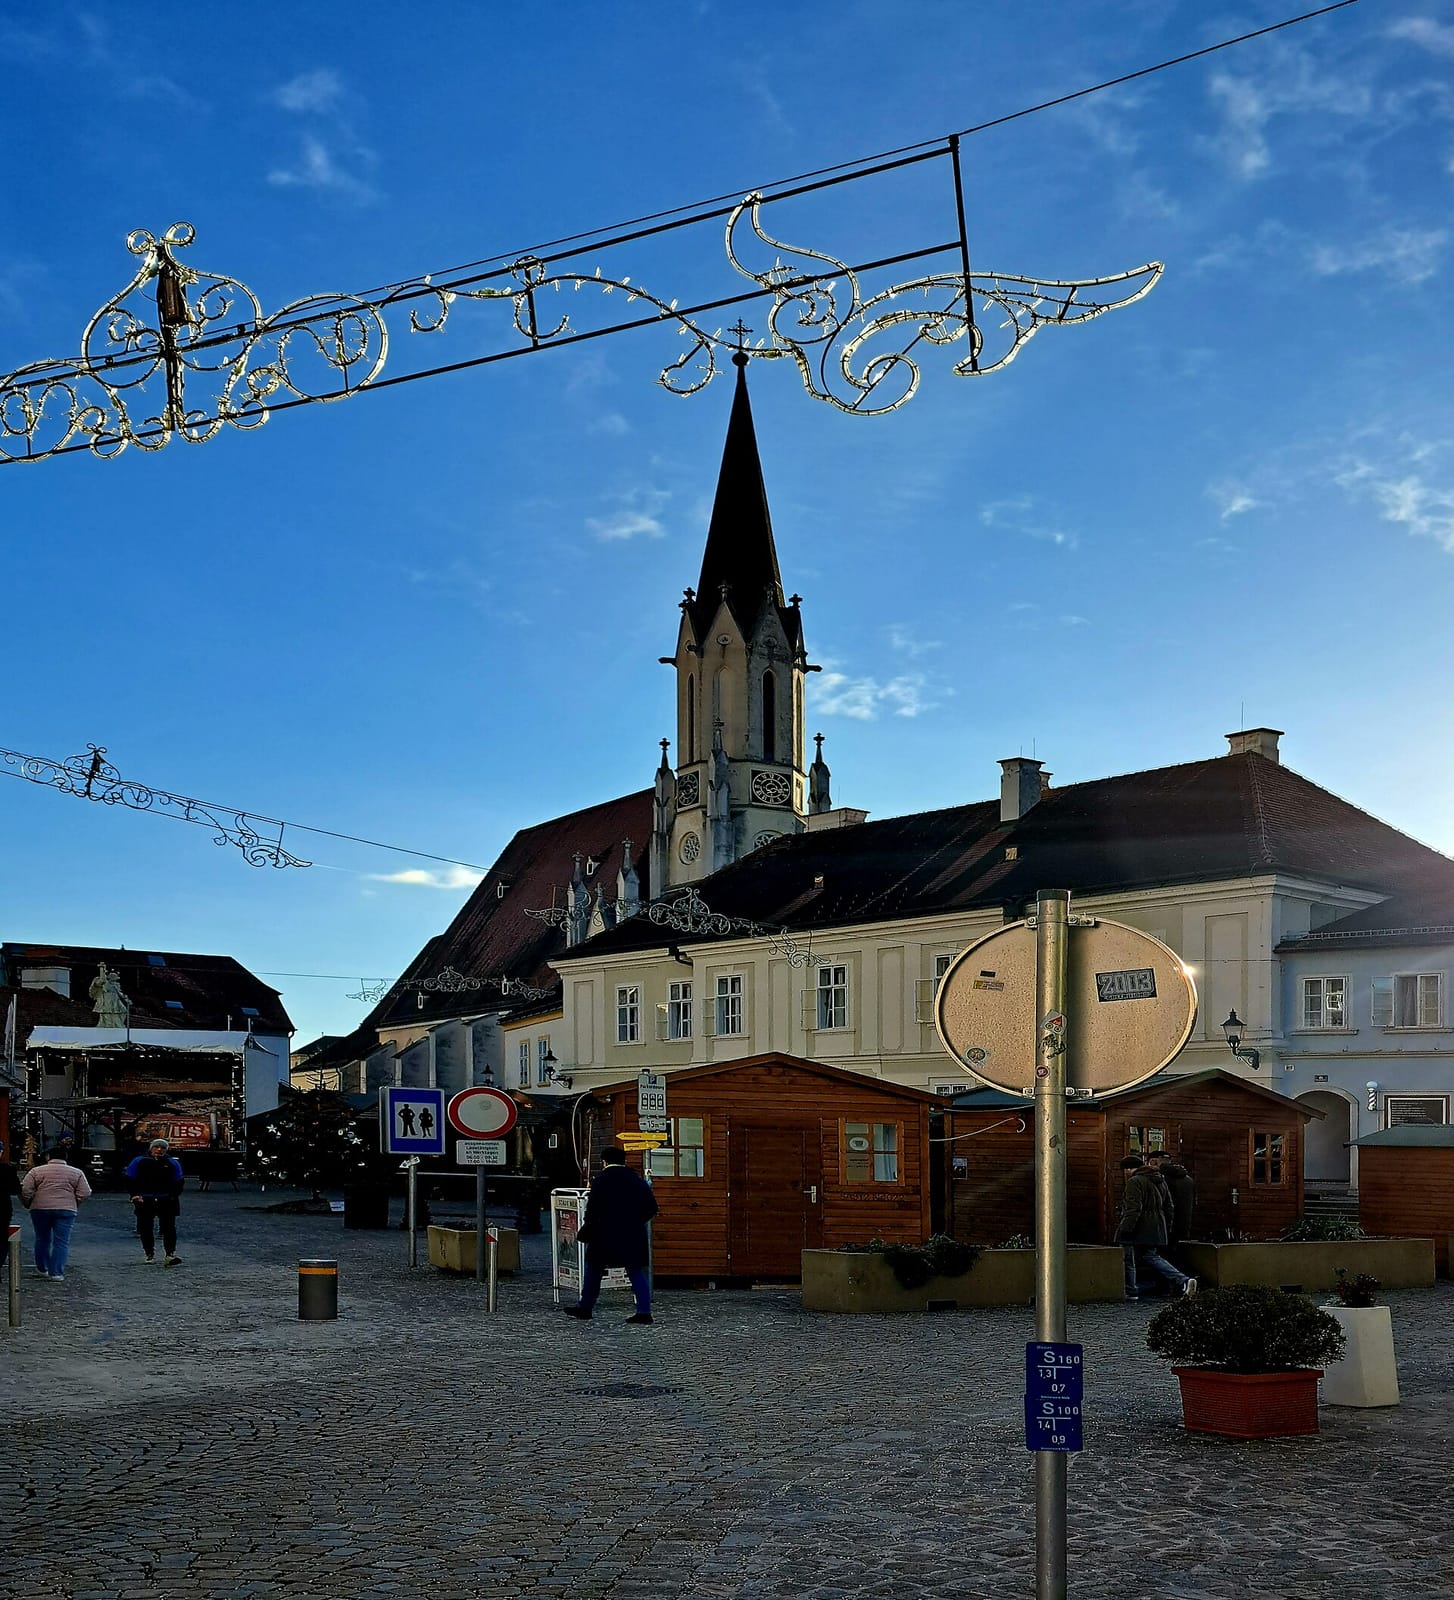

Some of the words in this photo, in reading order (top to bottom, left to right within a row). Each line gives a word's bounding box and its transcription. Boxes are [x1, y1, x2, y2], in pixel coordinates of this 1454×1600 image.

[1043, 1351, 1056, 1363] S
[1059, 1355, 1080, 1364] 160
[1042, 1402, 1055, 1415] S
[1058, 1406, 1079, 1415] 100
